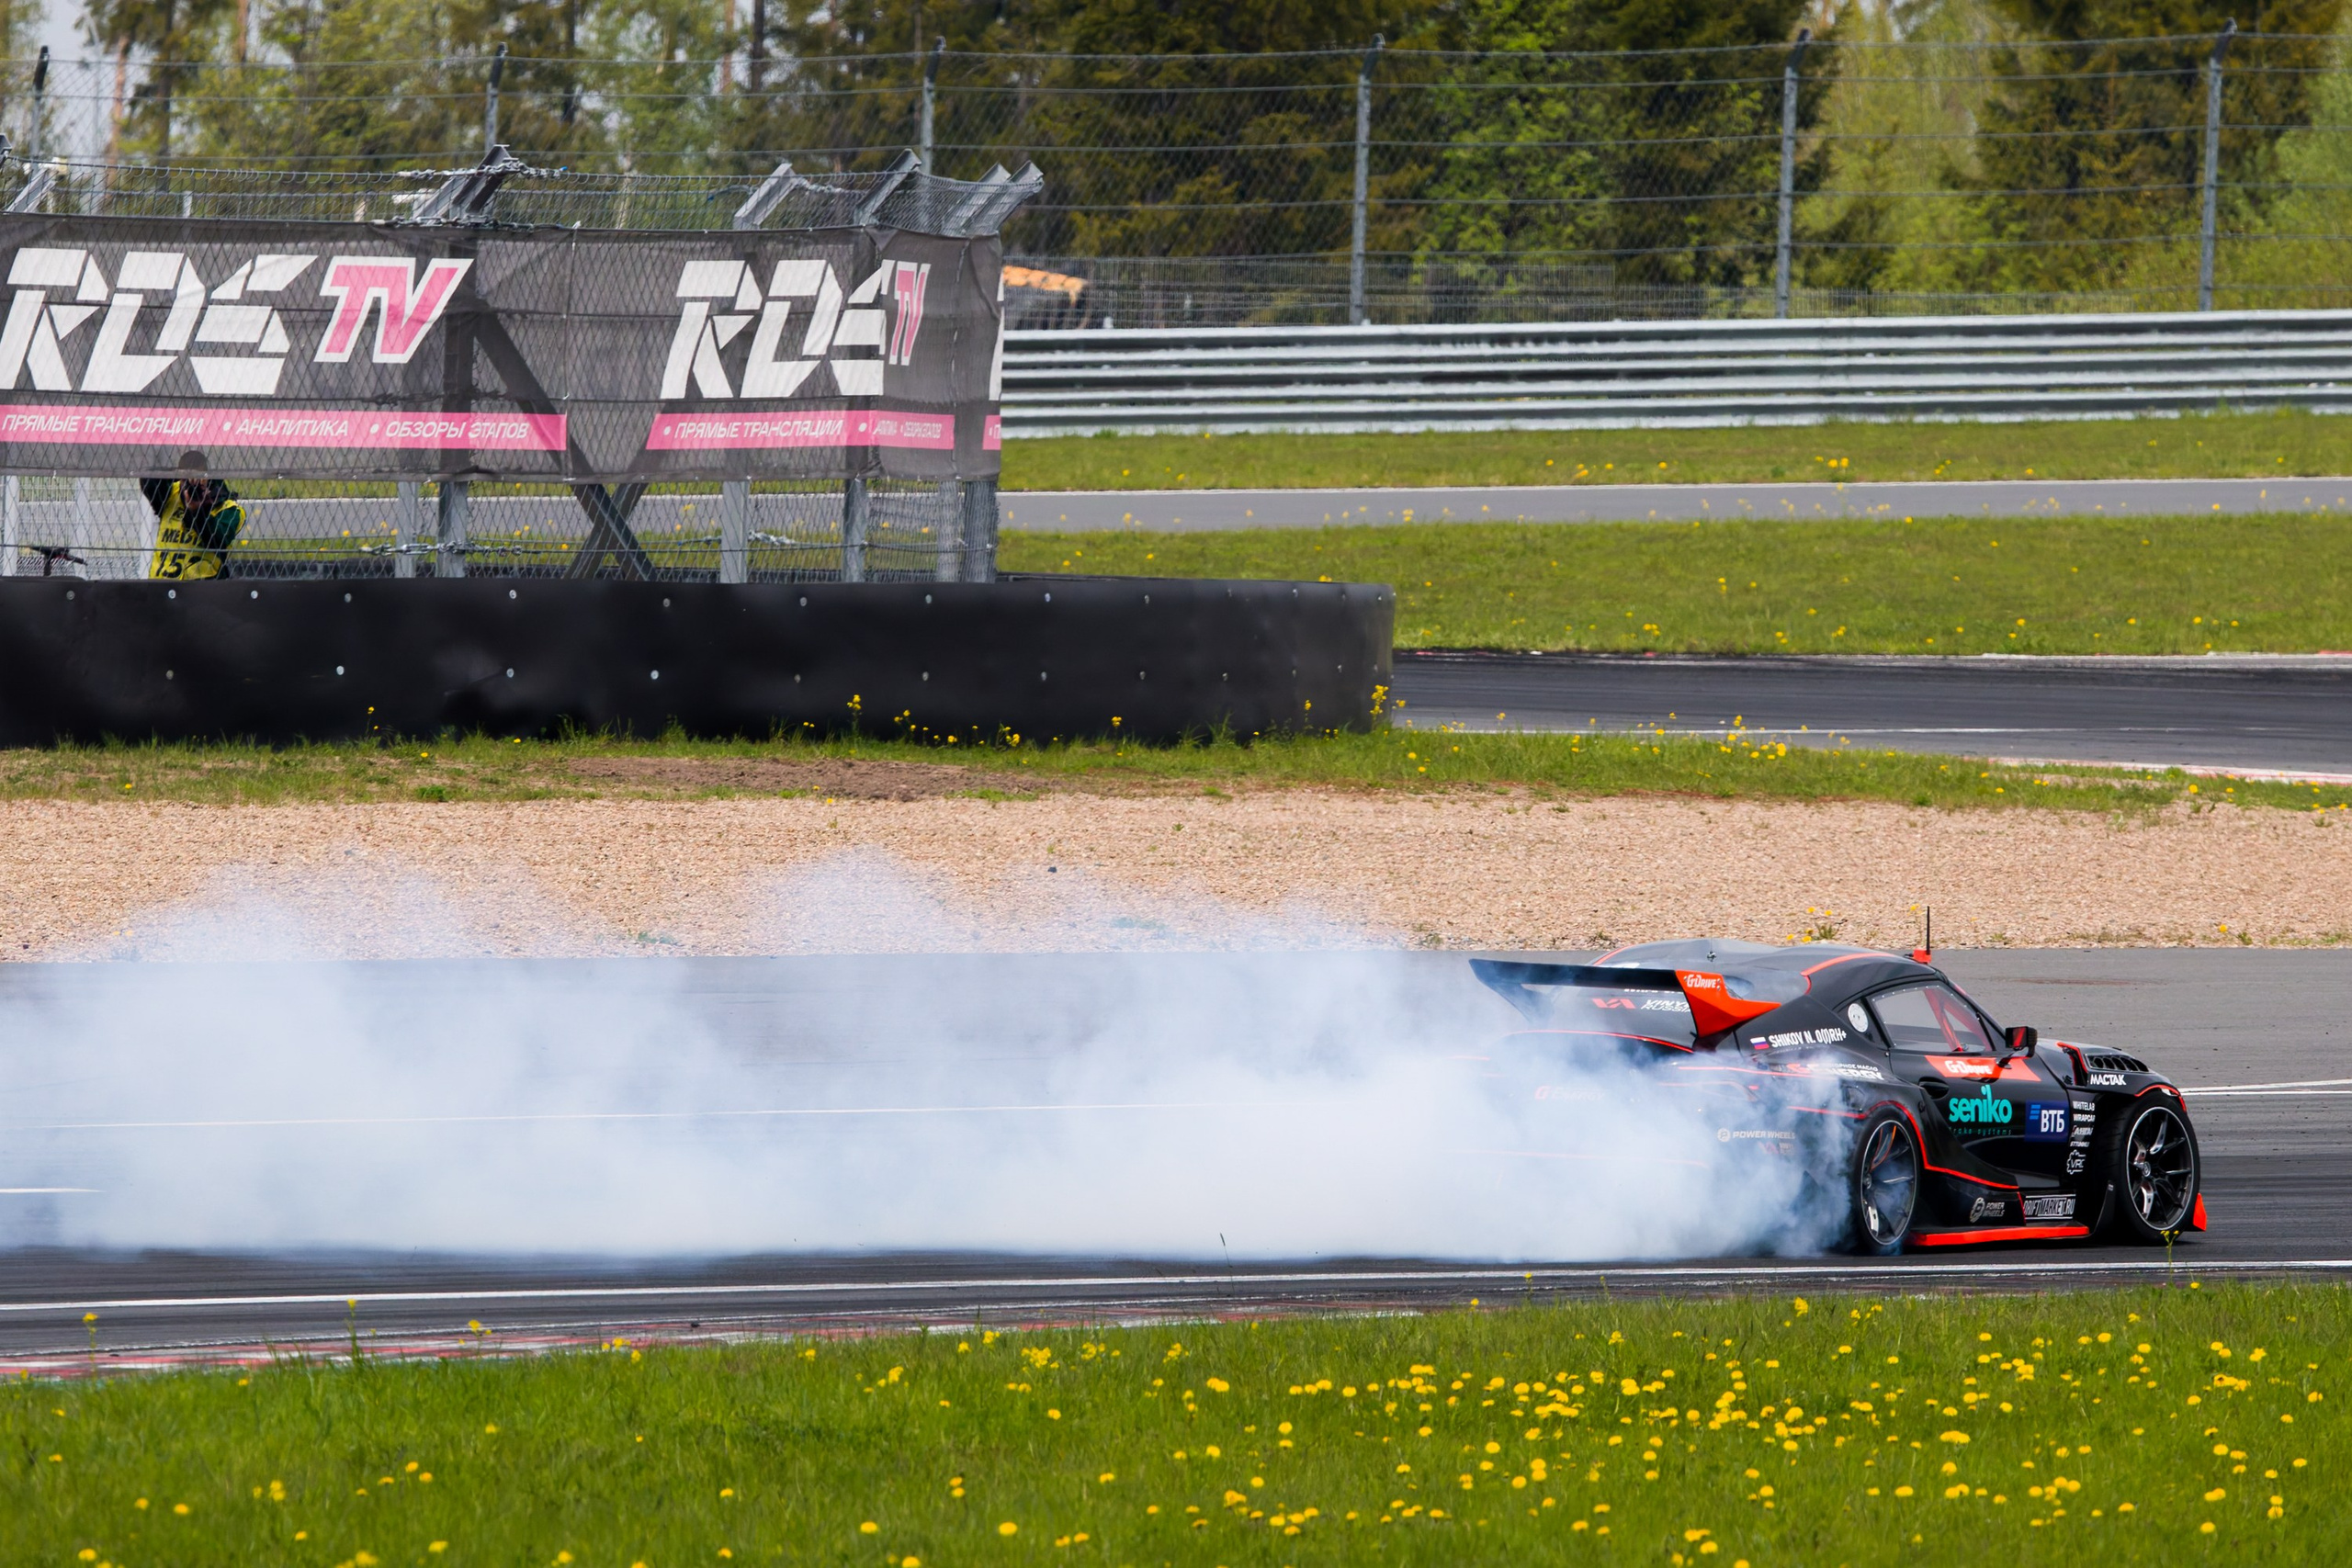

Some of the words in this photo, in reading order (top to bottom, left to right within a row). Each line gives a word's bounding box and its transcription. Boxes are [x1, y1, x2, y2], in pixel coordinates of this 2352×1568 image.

[0, 247, 318, 395] RDS
[313, 255, 474, 364] TV
[2, 413, 82, 433] ПРЯМЫЕ
[84, 414, 204, 436] ТРАНСЛЯЦИИ
[235, 419, 349, 436] АНАЛИТИКА
[385, 421, 466, 439] ОБЗОРЫ
[468, 422, 530, 439] ЭТАПОВ
[674, 422, 741, 439] ПРЯМЫЕ
[743, 419, 843, 438] ТРАНСЛЯЦИИ
[162, 528, 200, 546] MEDI
[1769, 1032, 1804, 1048] SHIKOV
[1804, 1030, 1815, 1044] N.
[1949, 1084, 2012, 1123] seniko
[2041, 1110, 2065, 1133] ВТБ
[1733, 1131, 1766, 1139] POWER
[1767, 1131, 1796, 1140] WHEELS
[1949, 1127, 1973, 1135] rake
[1983, 1209, 2005, 1217] WHEELS
[1985, 1201, 2005, 1210] POWER
